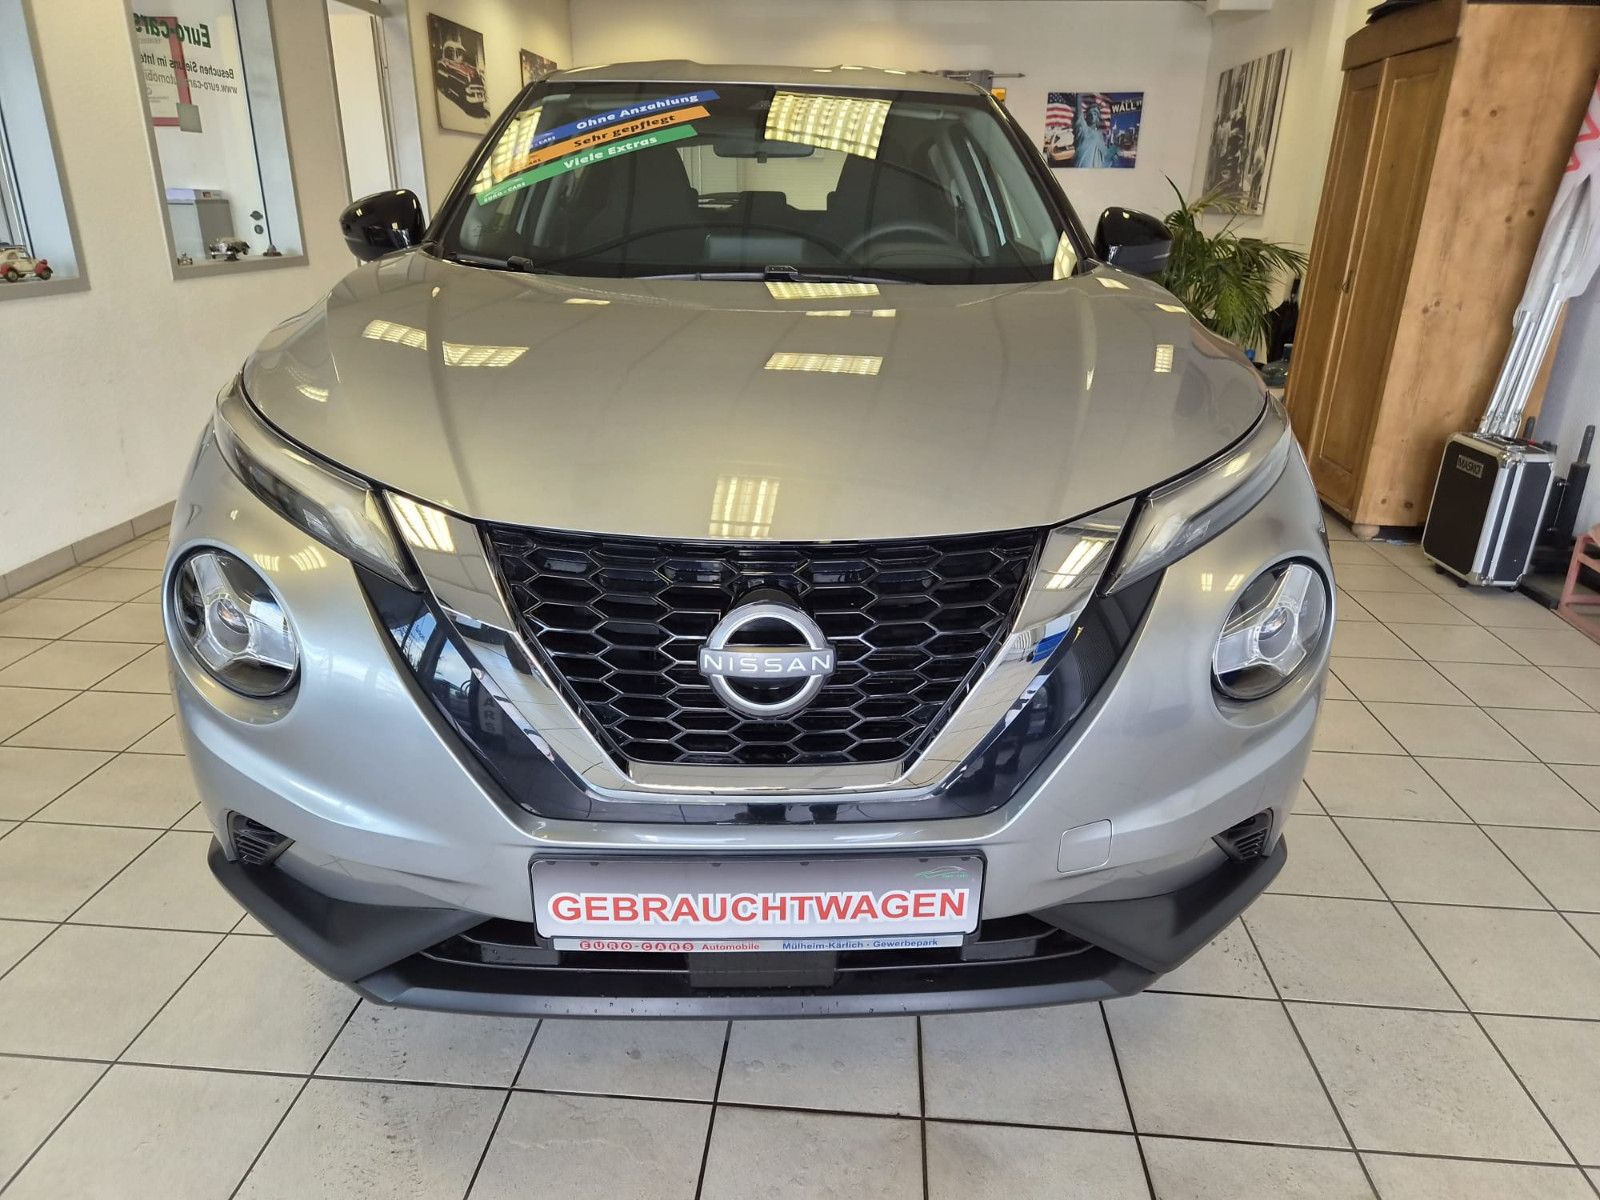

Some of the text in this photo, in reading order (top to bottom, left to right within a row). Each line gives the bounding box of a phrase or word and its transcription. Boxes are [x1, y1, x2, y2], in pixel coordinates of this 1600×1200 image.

[576, 94, 699, 131] Ohne Anzahlung
[1111, 99, 1136, 113] WALL
[574, 114, 676, 148] Sehr gepflegt
[563, 151, 604, 170] Viele
[608, 135, 658, 156] Extras
[704, 654, 830, 673] NISSAN
[550, 890, 968, 924] GEBRAUCHTWAGEN
[701, 942, 760, 951] Automobile
[782, 939, 864, 950] Mülheim-Kärlich
[873, 938, 938, 949] Gewerbepark
